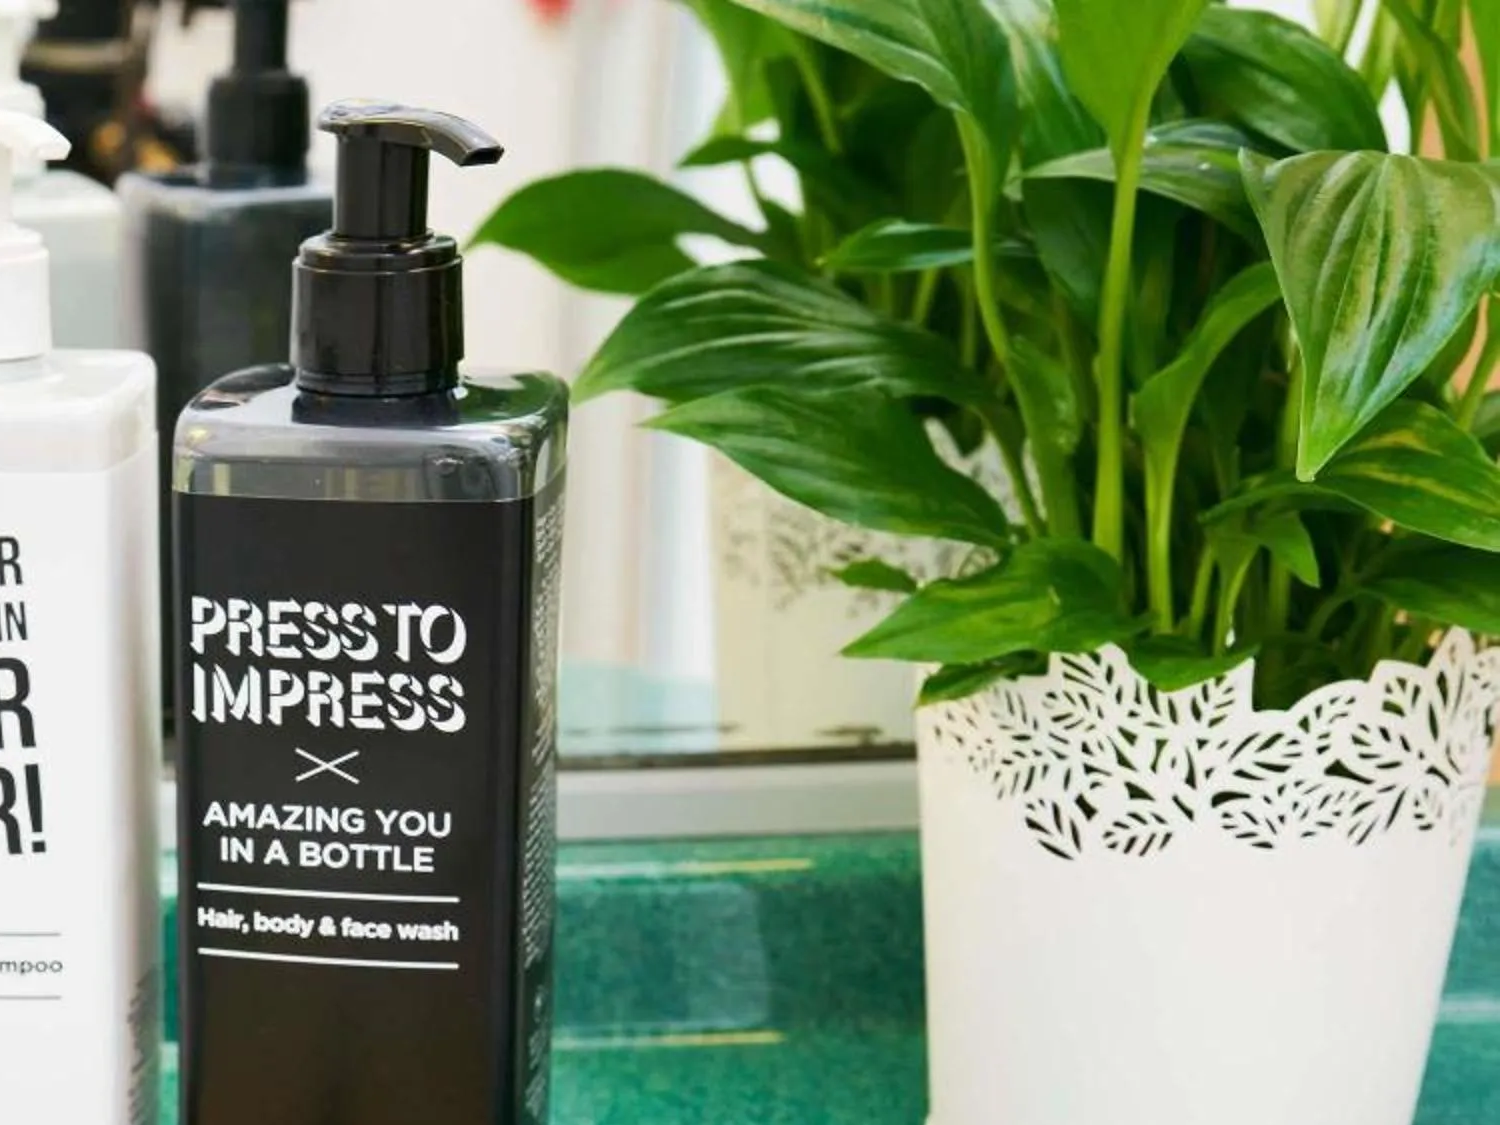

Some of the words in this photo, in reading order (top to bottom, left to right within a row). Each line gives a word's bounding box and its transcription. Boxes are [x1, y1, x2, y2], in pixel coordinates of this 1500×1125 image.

[190, 595, 379, 661] PRESS
[382, 602, 467, 664] TO
[191, 662, 467, 732] IMPRESS
[203, 801, 365, 834] AMAZING
[375, 809, 452, 838] YOU
[220, 837, 254, 862] IN
[264, 839, 290, 865] A
[300, 842, 435, 872] BOTTLE
[197, 907, 250, 934] Hair,
[254, 912, 314, 939] body
[319, 916, 337, 938] &
[341, 918, 392, 938] face
[397, 920, 459, 941] wash
